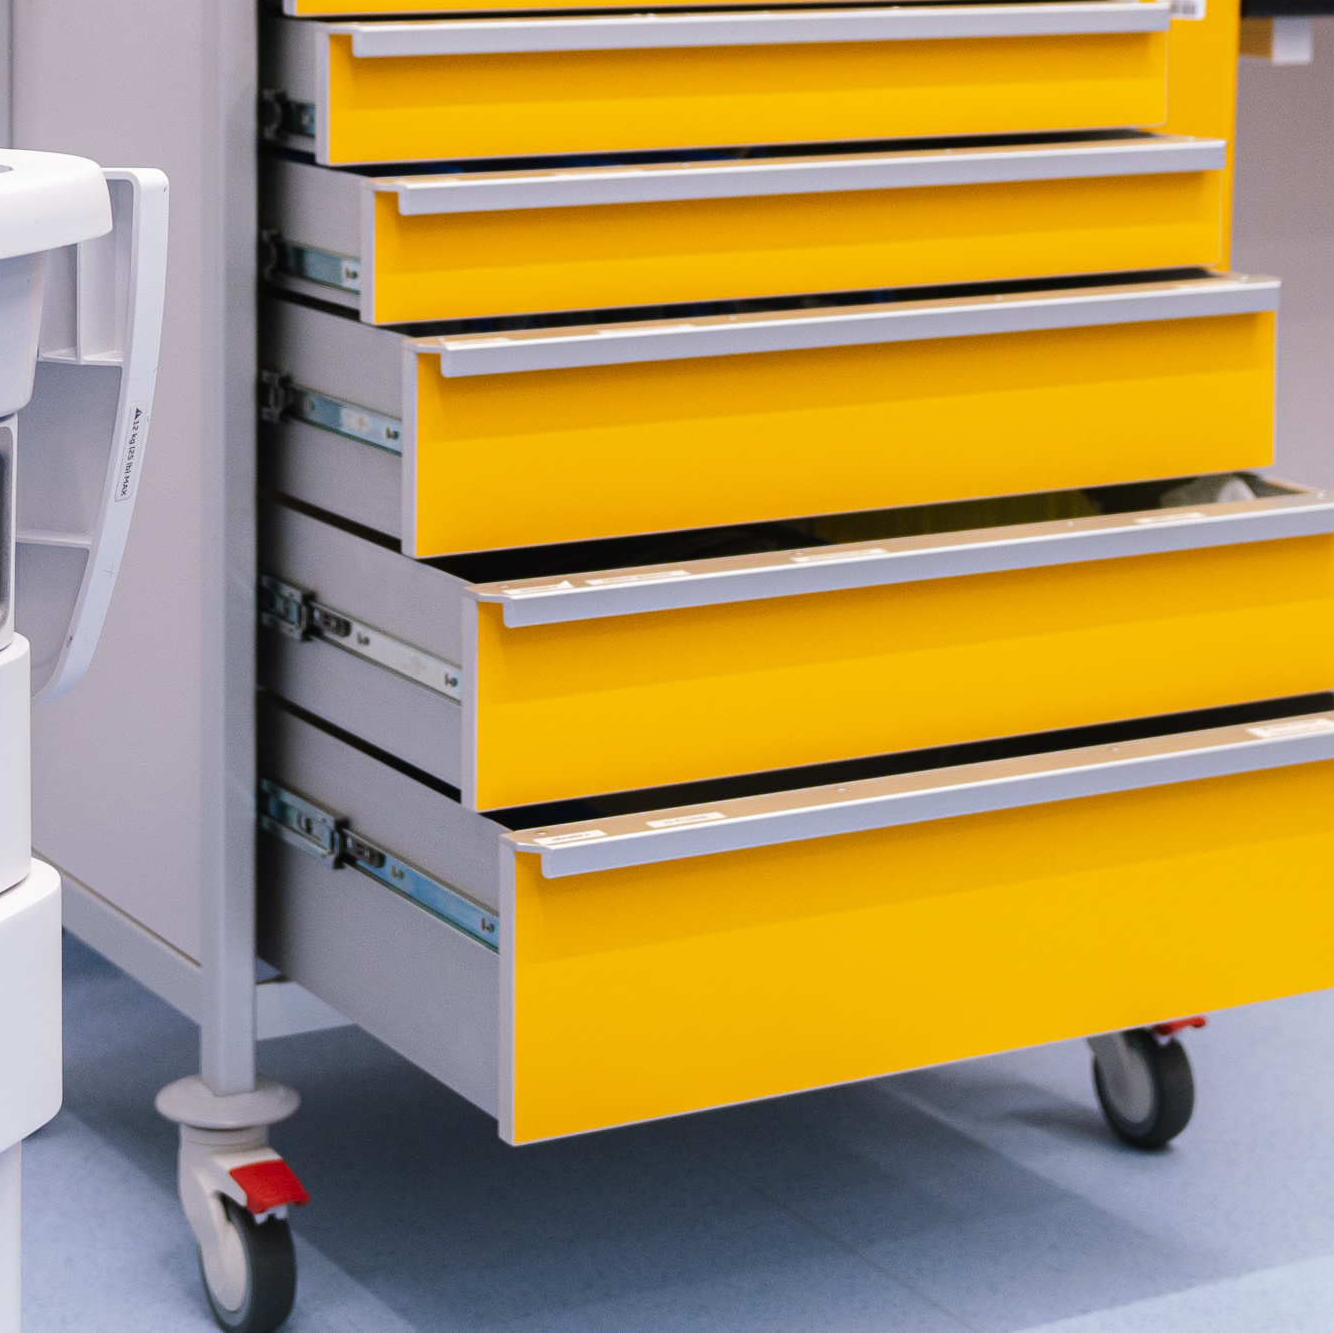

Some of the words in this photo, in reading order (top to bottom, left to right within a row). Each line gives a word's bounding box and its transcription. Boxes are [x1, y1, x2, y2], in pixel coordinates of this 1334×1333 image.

[132, 420, 140, 431] 12
[128, 433, 138, 445] kg
[120, 475, 130, 497] MAX
